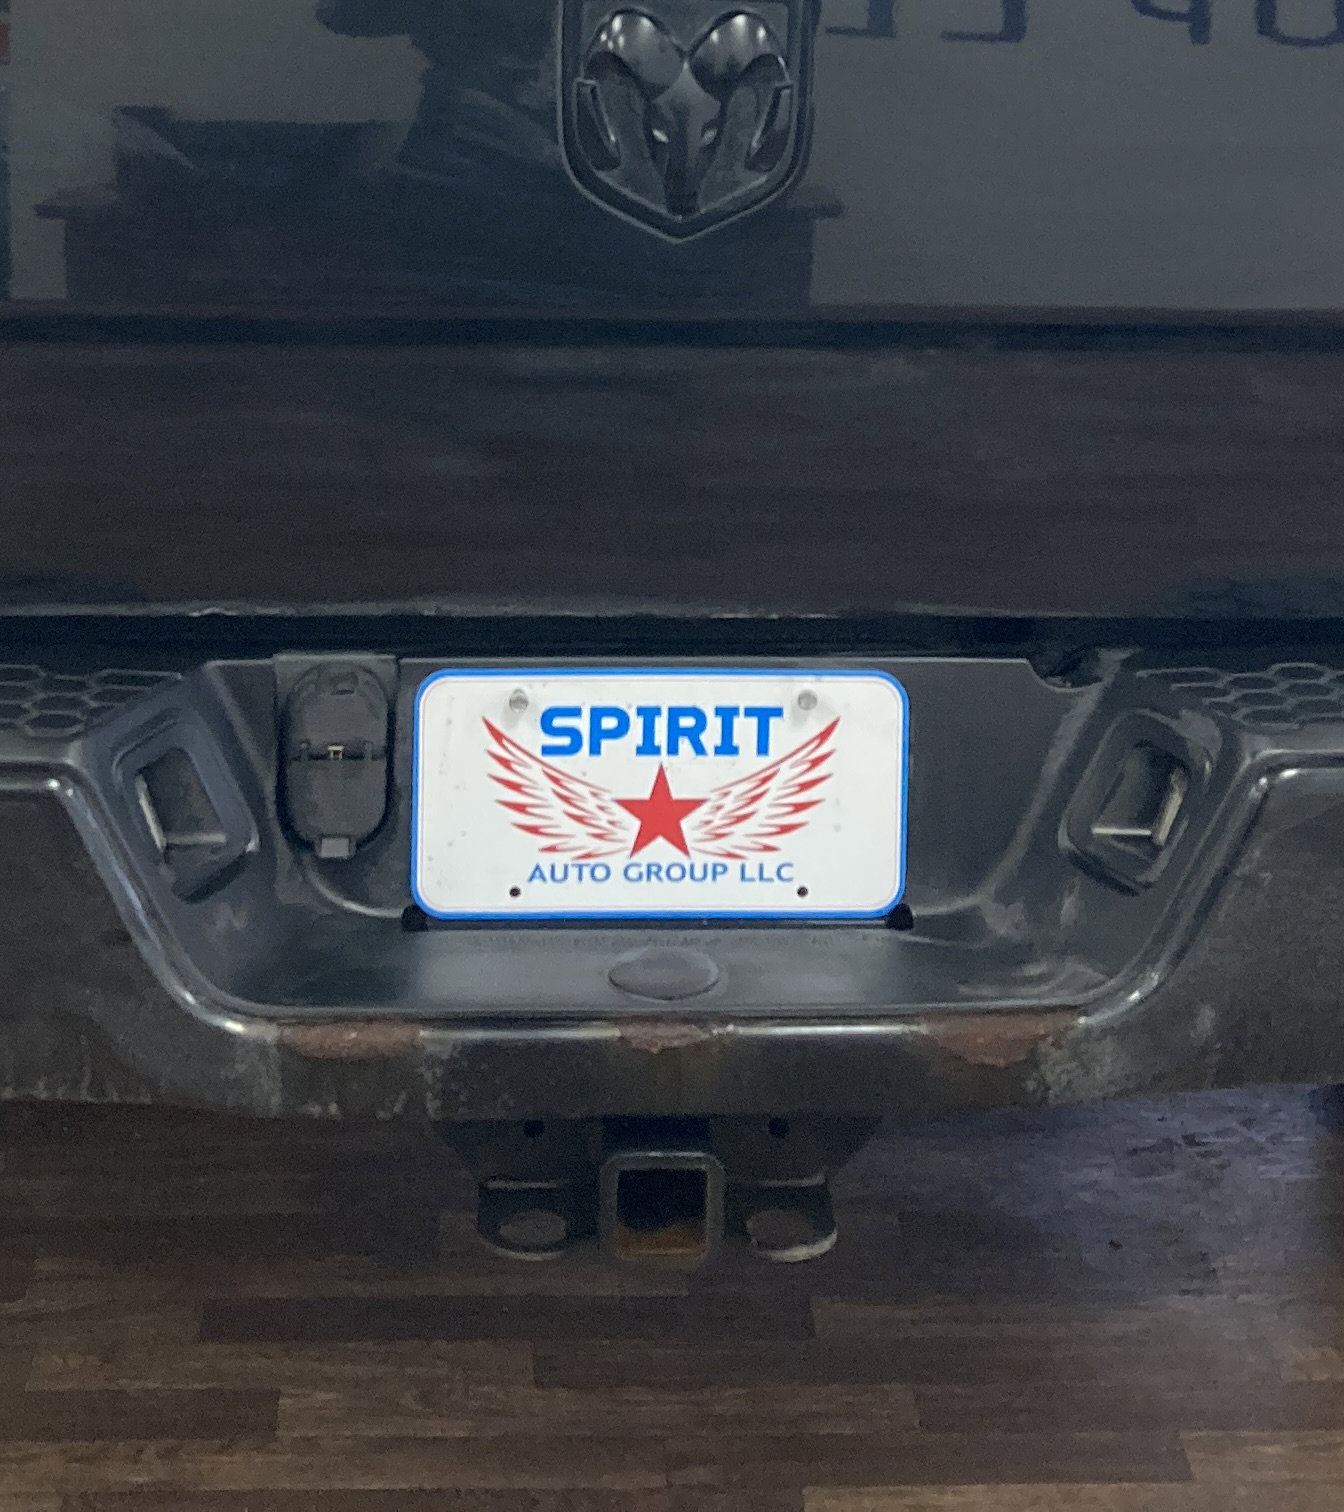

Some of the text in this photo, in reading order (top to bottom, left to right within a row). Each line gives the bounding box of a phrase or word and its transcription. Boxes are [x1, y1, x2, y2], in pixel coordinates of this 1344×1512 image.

[540, 706, 783, 756] SPIRIT
[528, 862, 794, 884] AUTO GROUP LLC
